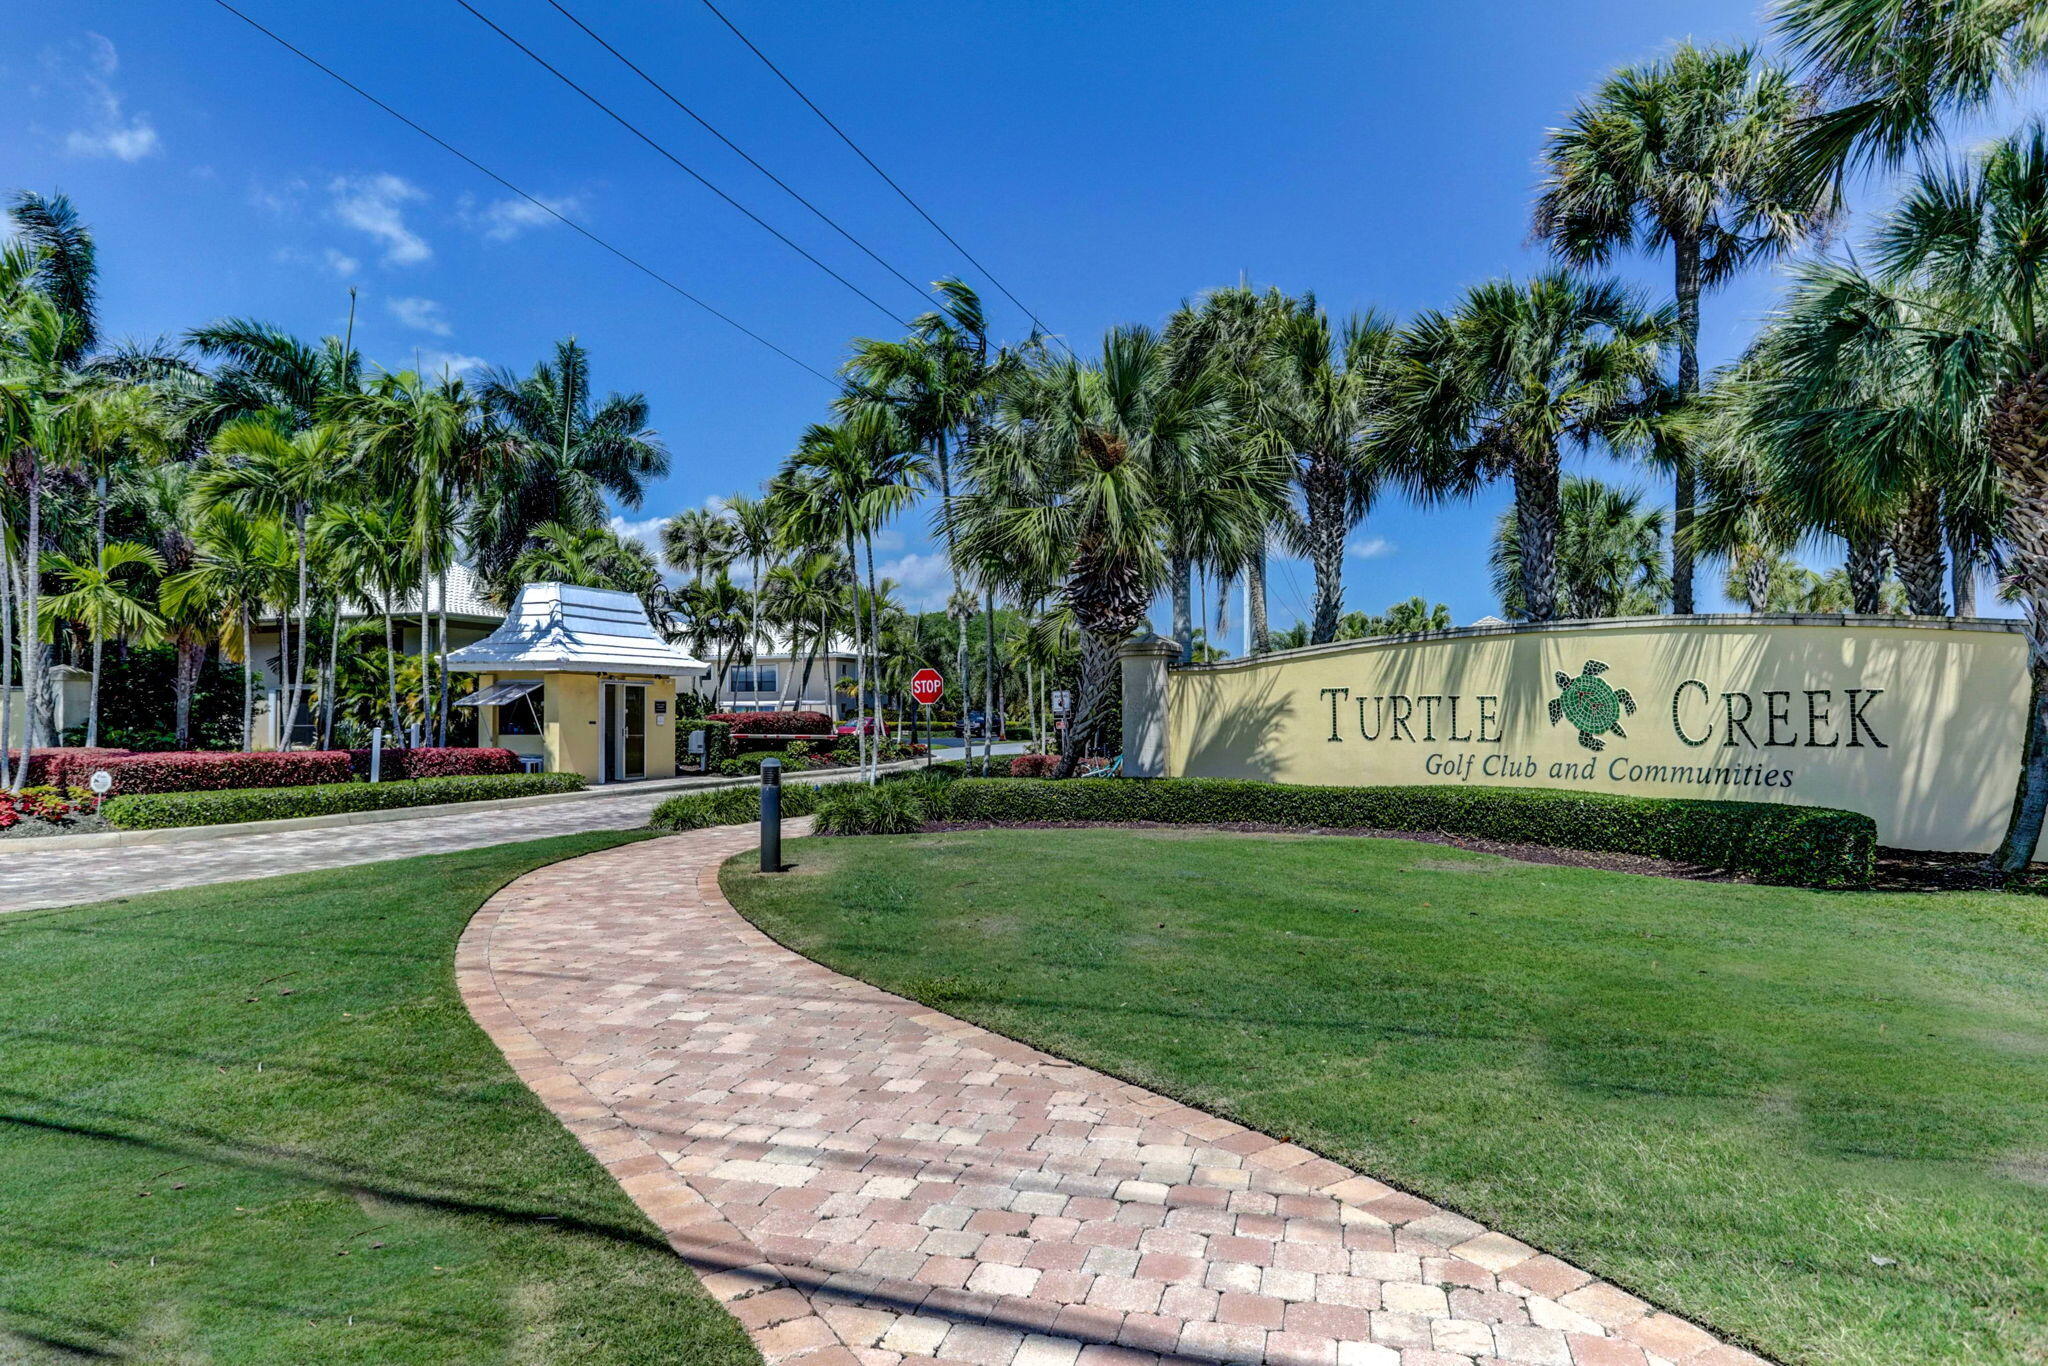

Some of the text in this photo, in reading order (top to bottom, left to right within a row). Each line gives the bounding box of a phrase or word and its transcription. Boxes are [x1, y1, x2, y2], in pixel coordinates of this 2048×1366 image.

[914, 680, 941, 693] STOP
[1320, 679, 1889, 750] TURTLE CREEK
[1425, 753, 1794, 788] Golf Club and Communities
